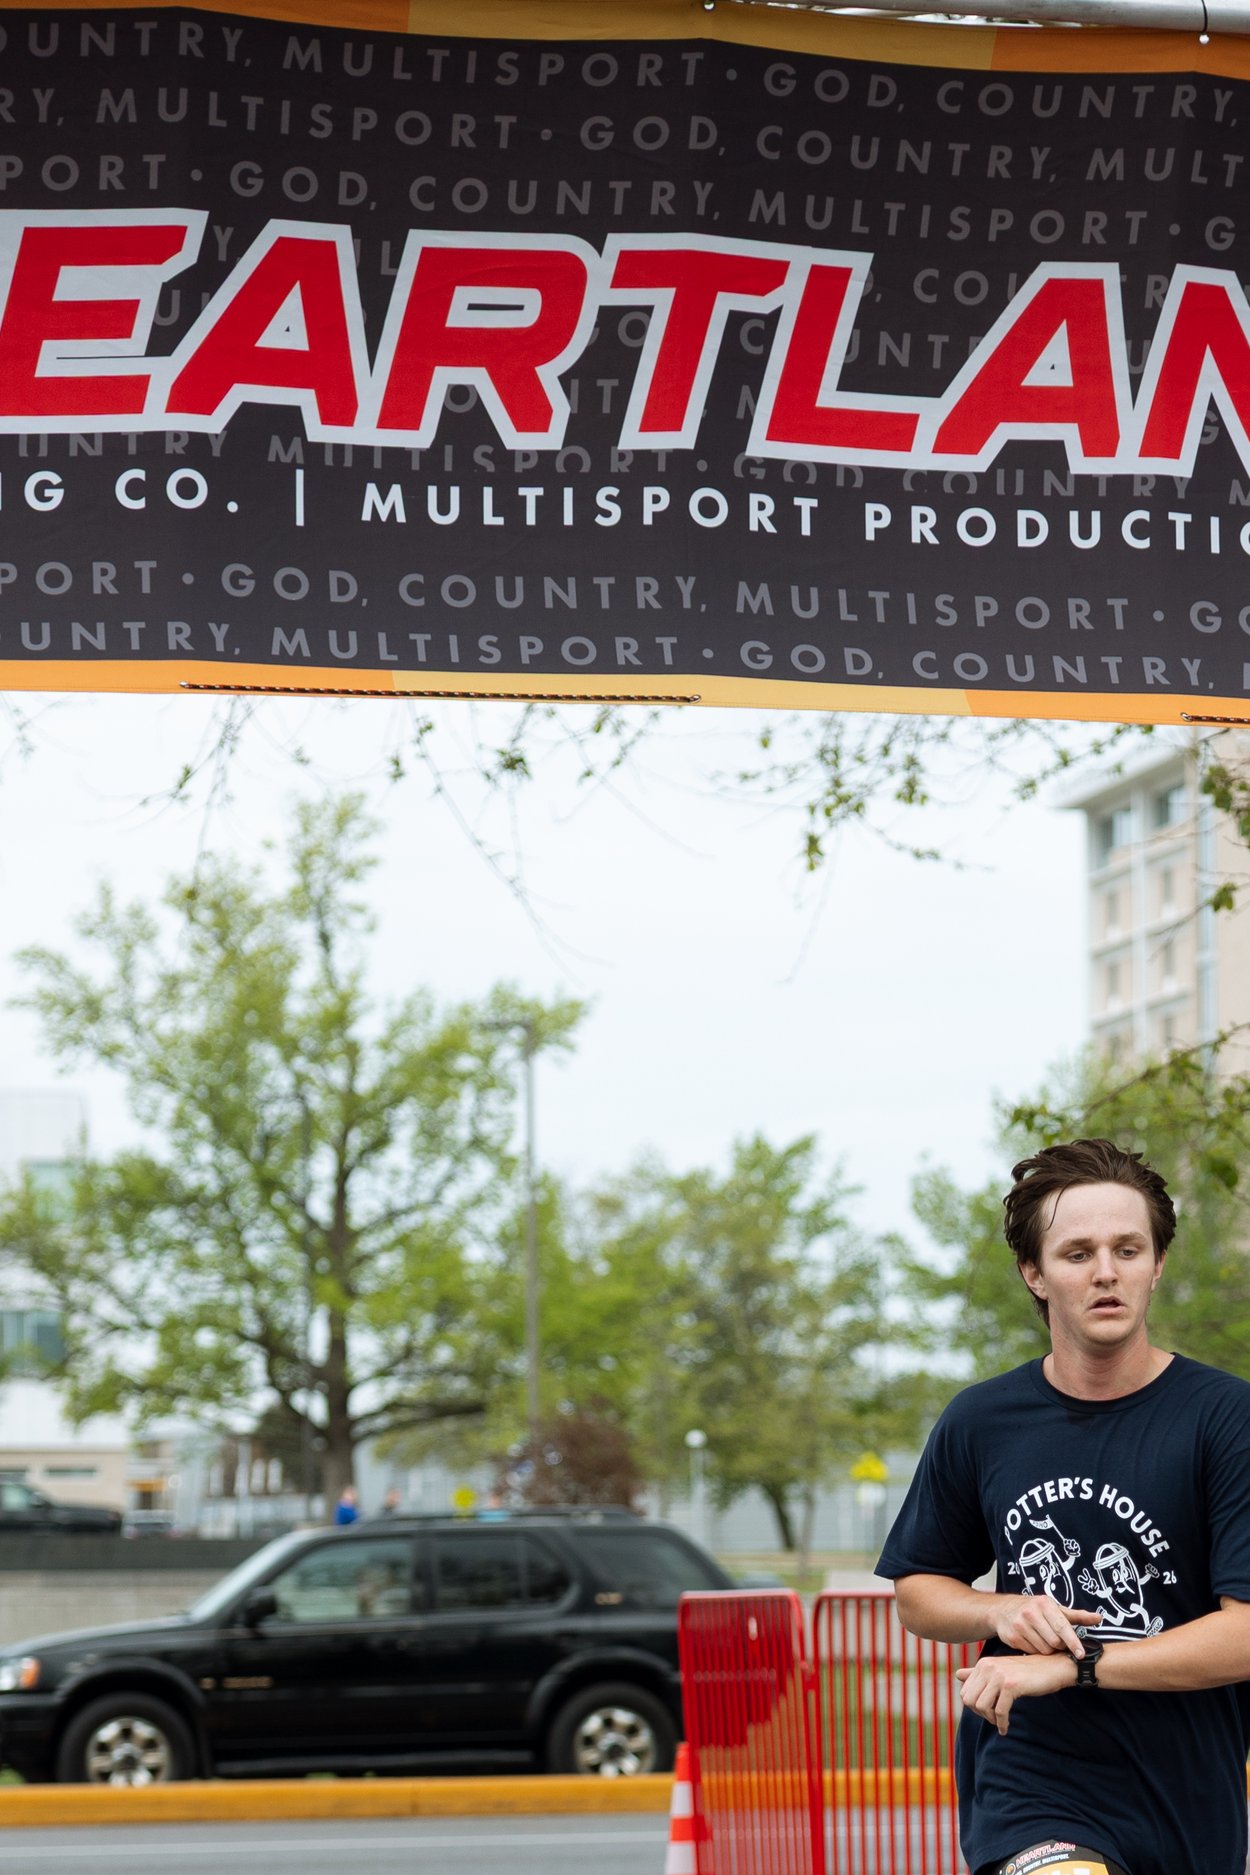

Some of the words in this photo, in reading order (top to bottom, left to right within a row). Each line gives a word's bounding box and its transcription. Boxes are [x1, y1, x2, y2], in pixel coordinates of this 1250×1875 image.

[0, 21, 252, 67] UNTRY,
[282, 36, 704, 87] MULTISPORT
[96, 87, 516, 149] MULTISPORT
[749, 189, 1147, 245] MULTISPORT
[114, 467, 239, 513] CO.
[361, 482, 818, 536] MULTISPORT
[736, 580, 1128, 631] MULTISPORT
[271, 627, 677, 666] MULTISPORT
[1099, 1484, 1170, 1558] HOUSE
[1163, 1571, 1177, 1584] 26
